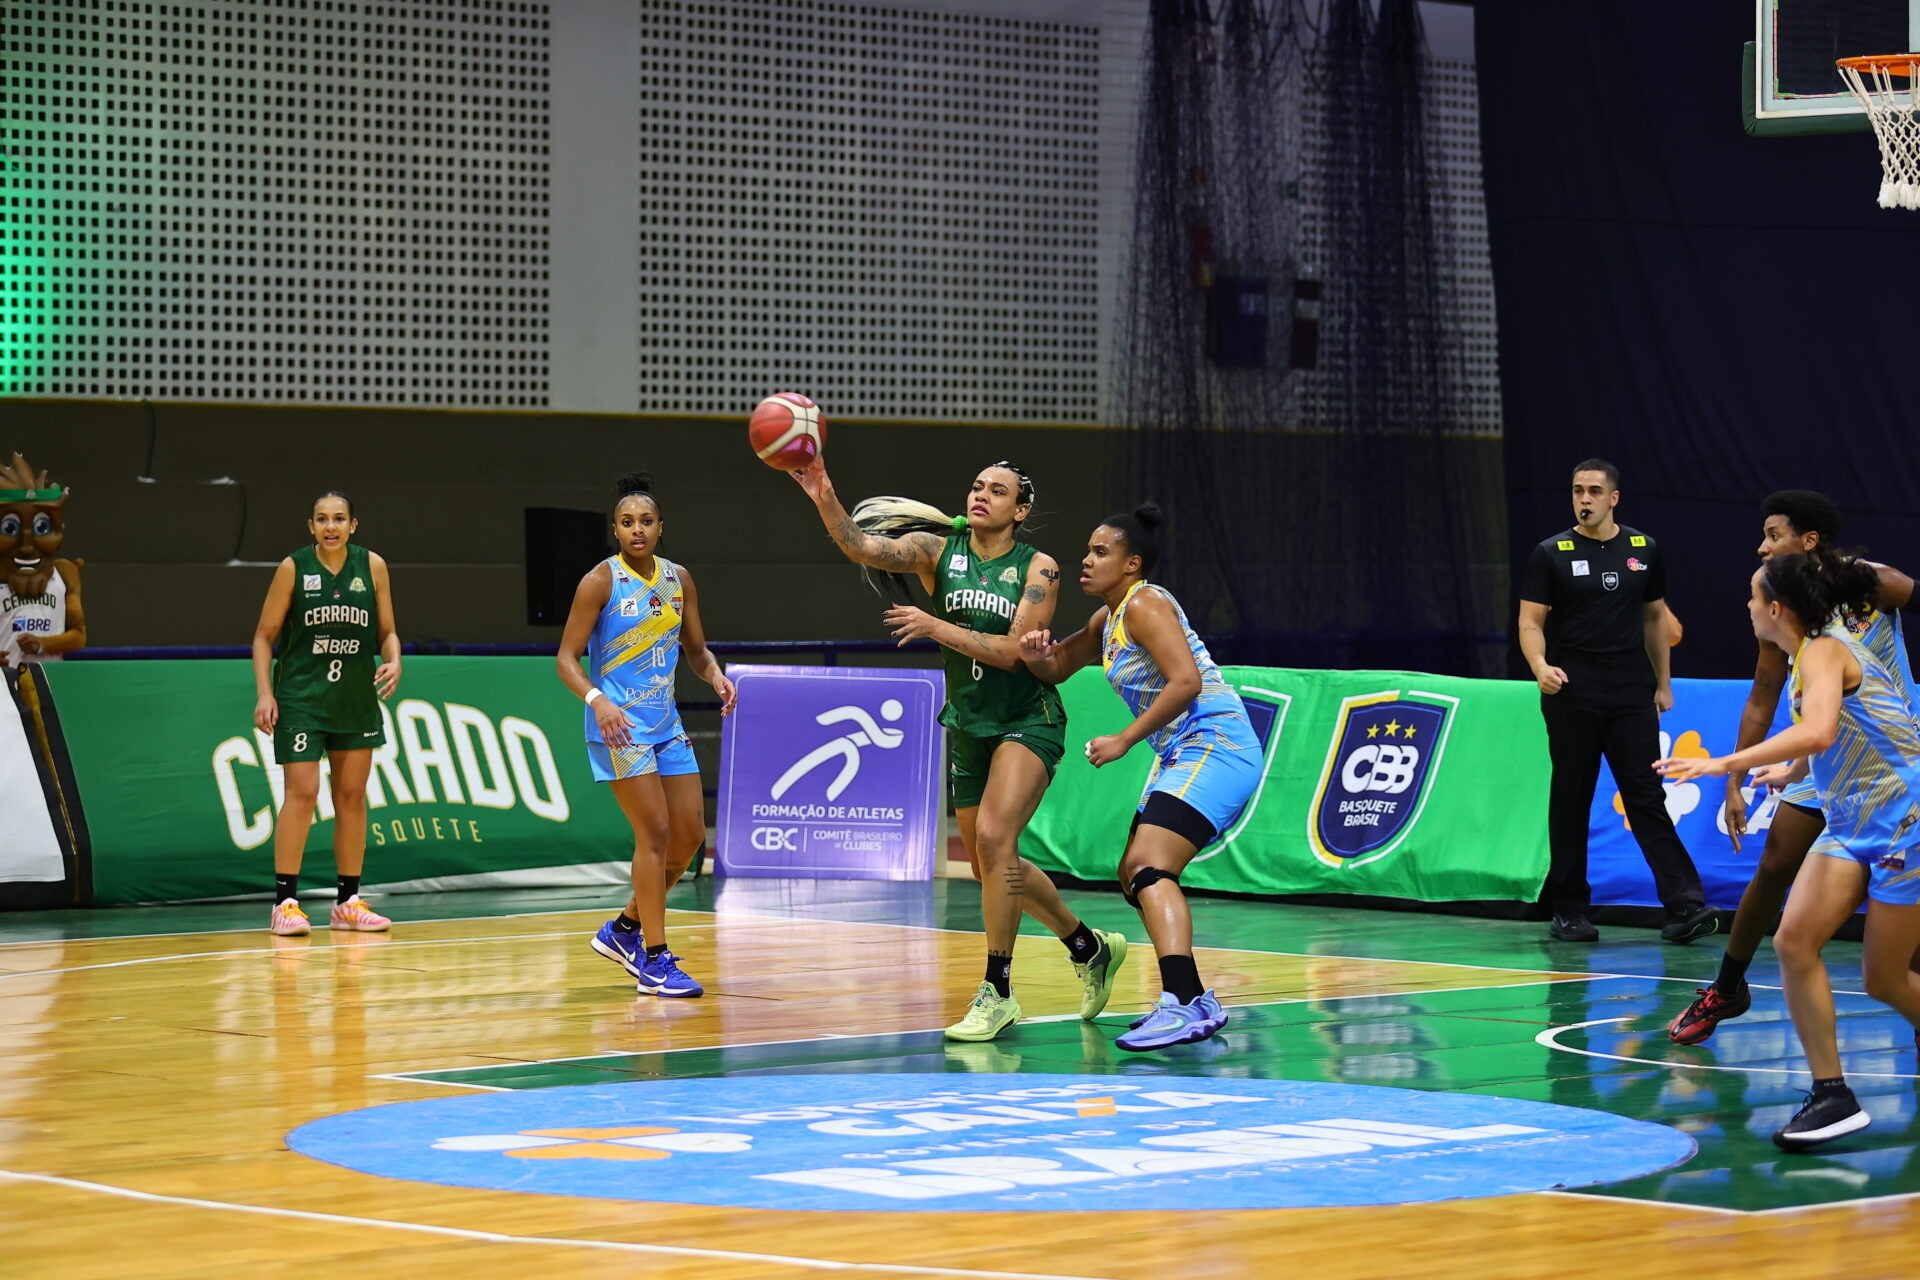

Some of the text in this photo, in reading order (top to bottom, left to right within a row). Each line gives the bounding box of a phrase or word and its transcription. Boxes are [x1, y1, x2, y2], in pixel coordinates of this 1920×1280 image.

[27, 618, 51, 631] BRB
[304, 605, 369, 627] CERRADO
[329, 639, 360, 654] BRB
[327, 659, 343, 682] 8
[972, 658, 983, 680] 6
[293, 733, 308, 752] 8
[1342, 744, 1419, 793] CBB
[752, 804, 904, 820] FORMAÇÃO DE ATLETAS
[1338, 799, 1398, 814] BASQUETE
[1344, 813, 1380, 826] BRASIL
[372, 817, 482, 845] SQUETE
[751, 827, 798, 851] CBC
[813, 829, 903, 842] COMITÊ BRASILEIRO
[843, 841, 882, 851] CLUBES
[669, 1083, 1143, 1125] loterias
[807, 1091, 1274, 1136] CAIXA
[750, 1118, 1558, 1200] BRASIL
